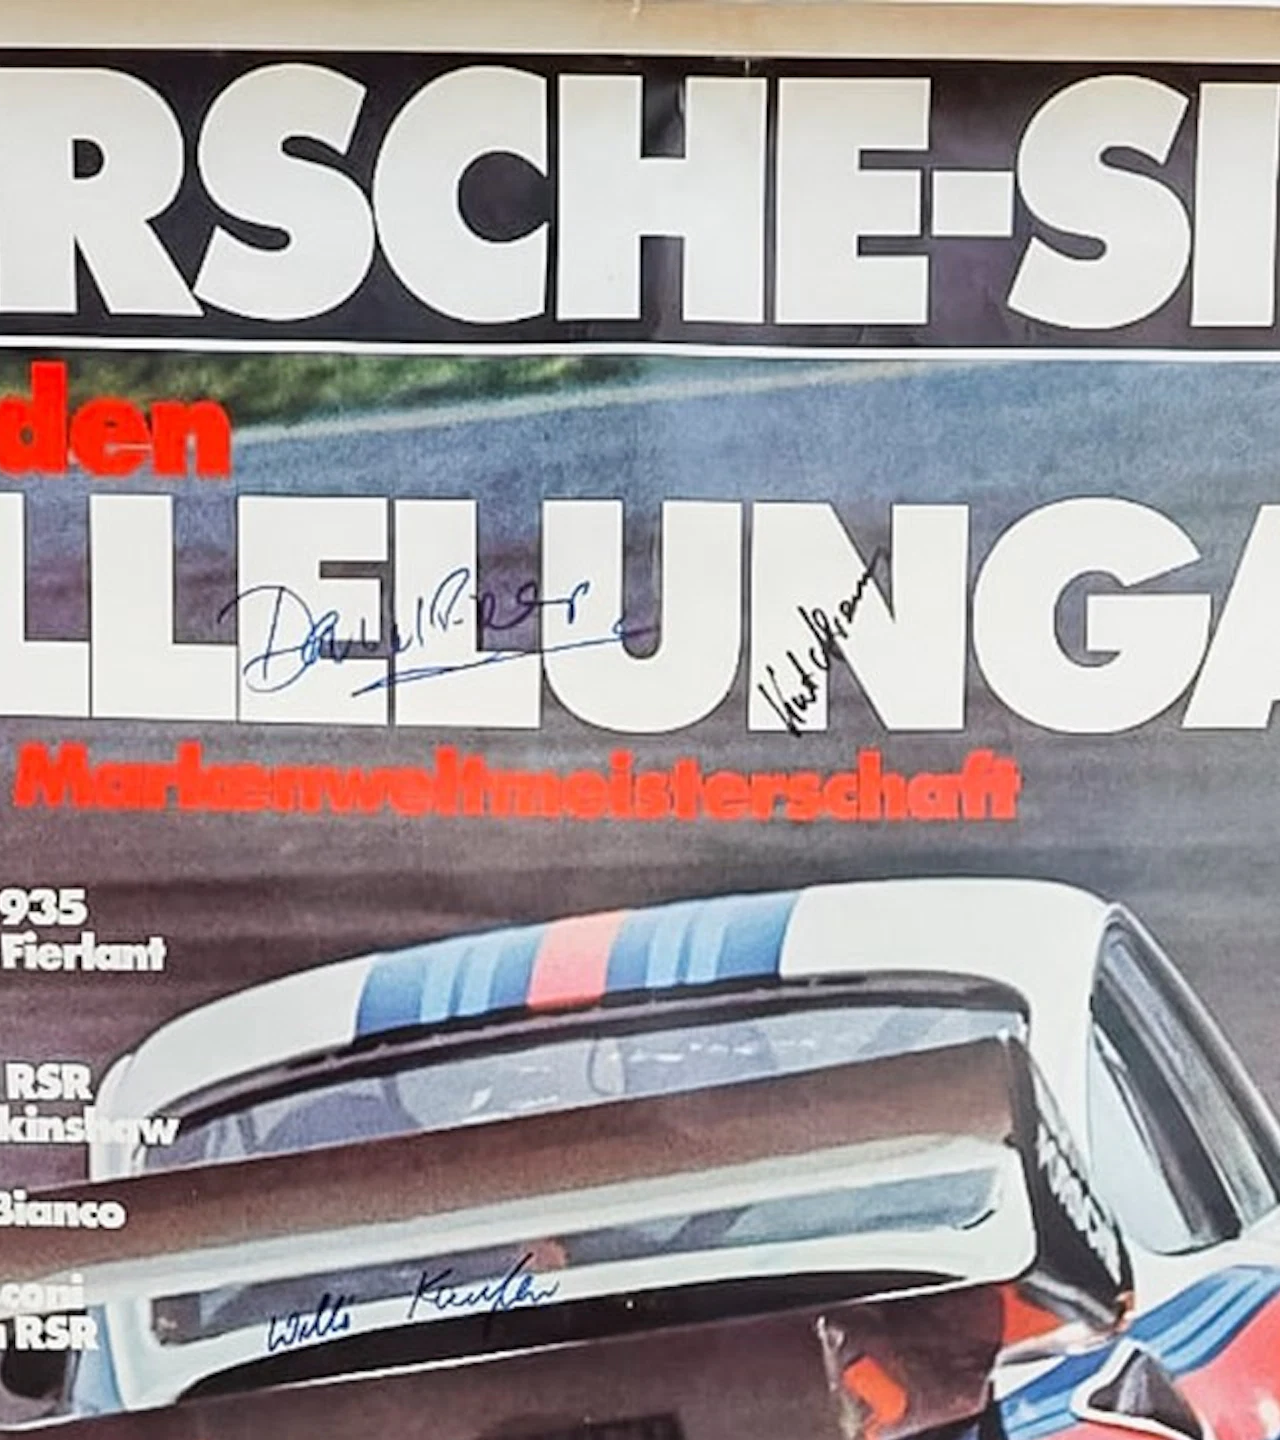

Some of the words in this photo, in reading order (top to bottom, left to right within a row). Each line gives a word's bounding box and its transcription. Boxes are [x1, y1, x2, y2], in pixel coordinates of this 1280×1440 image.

[12, 740, 1022, 822] Markenweltmeisterschaft
[1, 934, 168, 972] Fierlant
[6, 1064, 92, 1099] RSR
[15, 1315, 99, 1350] RSR
